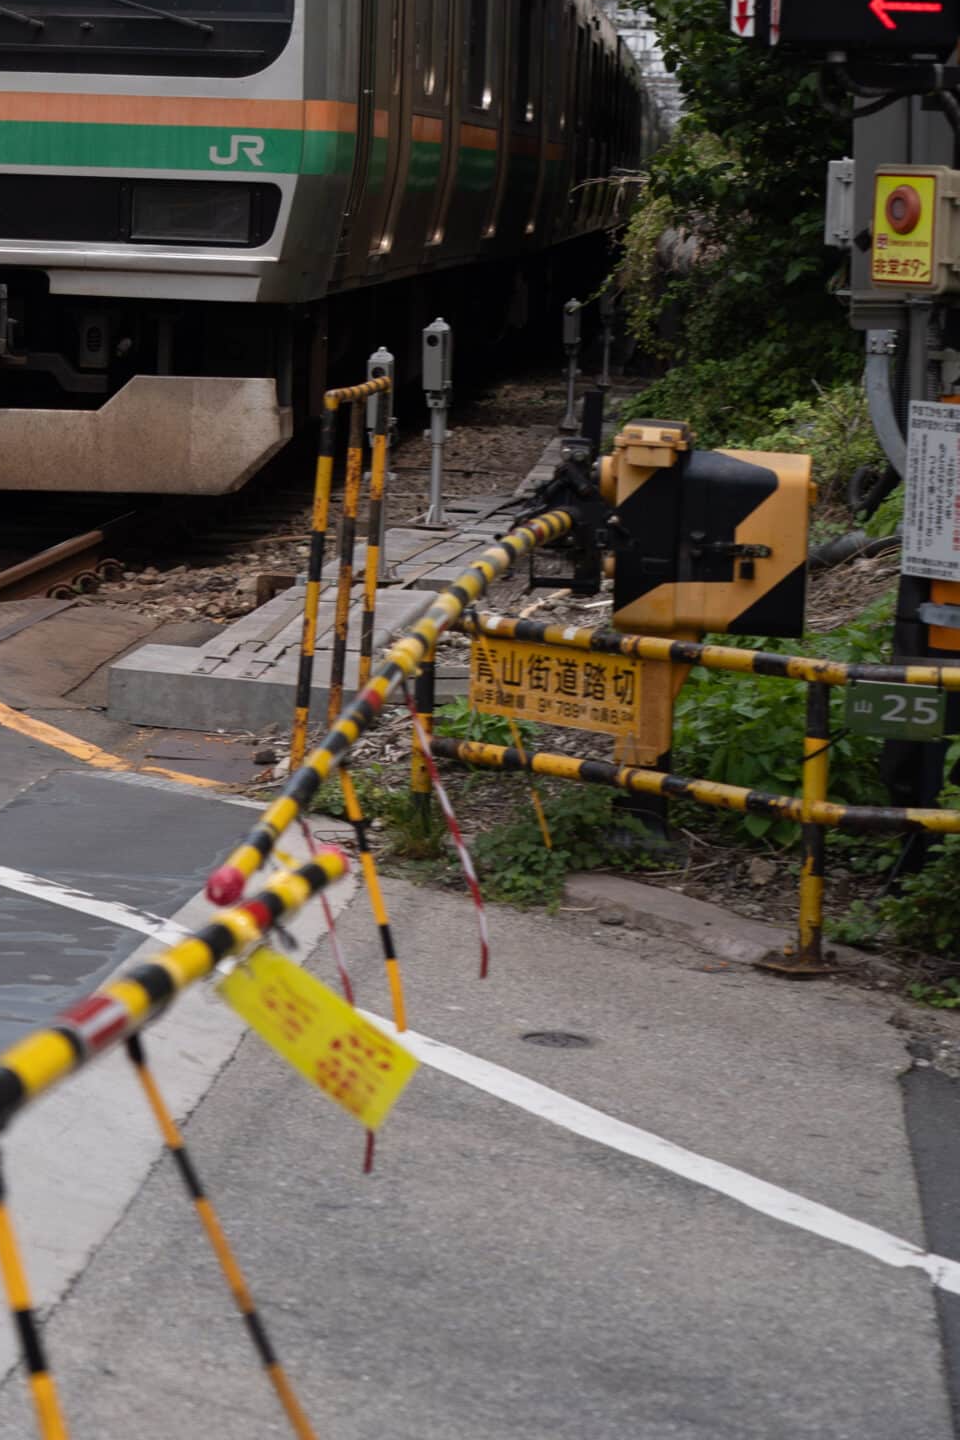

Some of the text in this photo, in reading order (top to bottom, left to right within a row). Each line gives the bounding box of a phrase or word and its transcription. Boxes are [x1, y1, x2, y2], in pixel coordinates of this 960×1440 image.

[209, 134, 265, 167] JR
[475, 647, 637, 706] 青山街道踏切
[880, 694, 939, 725] 25
